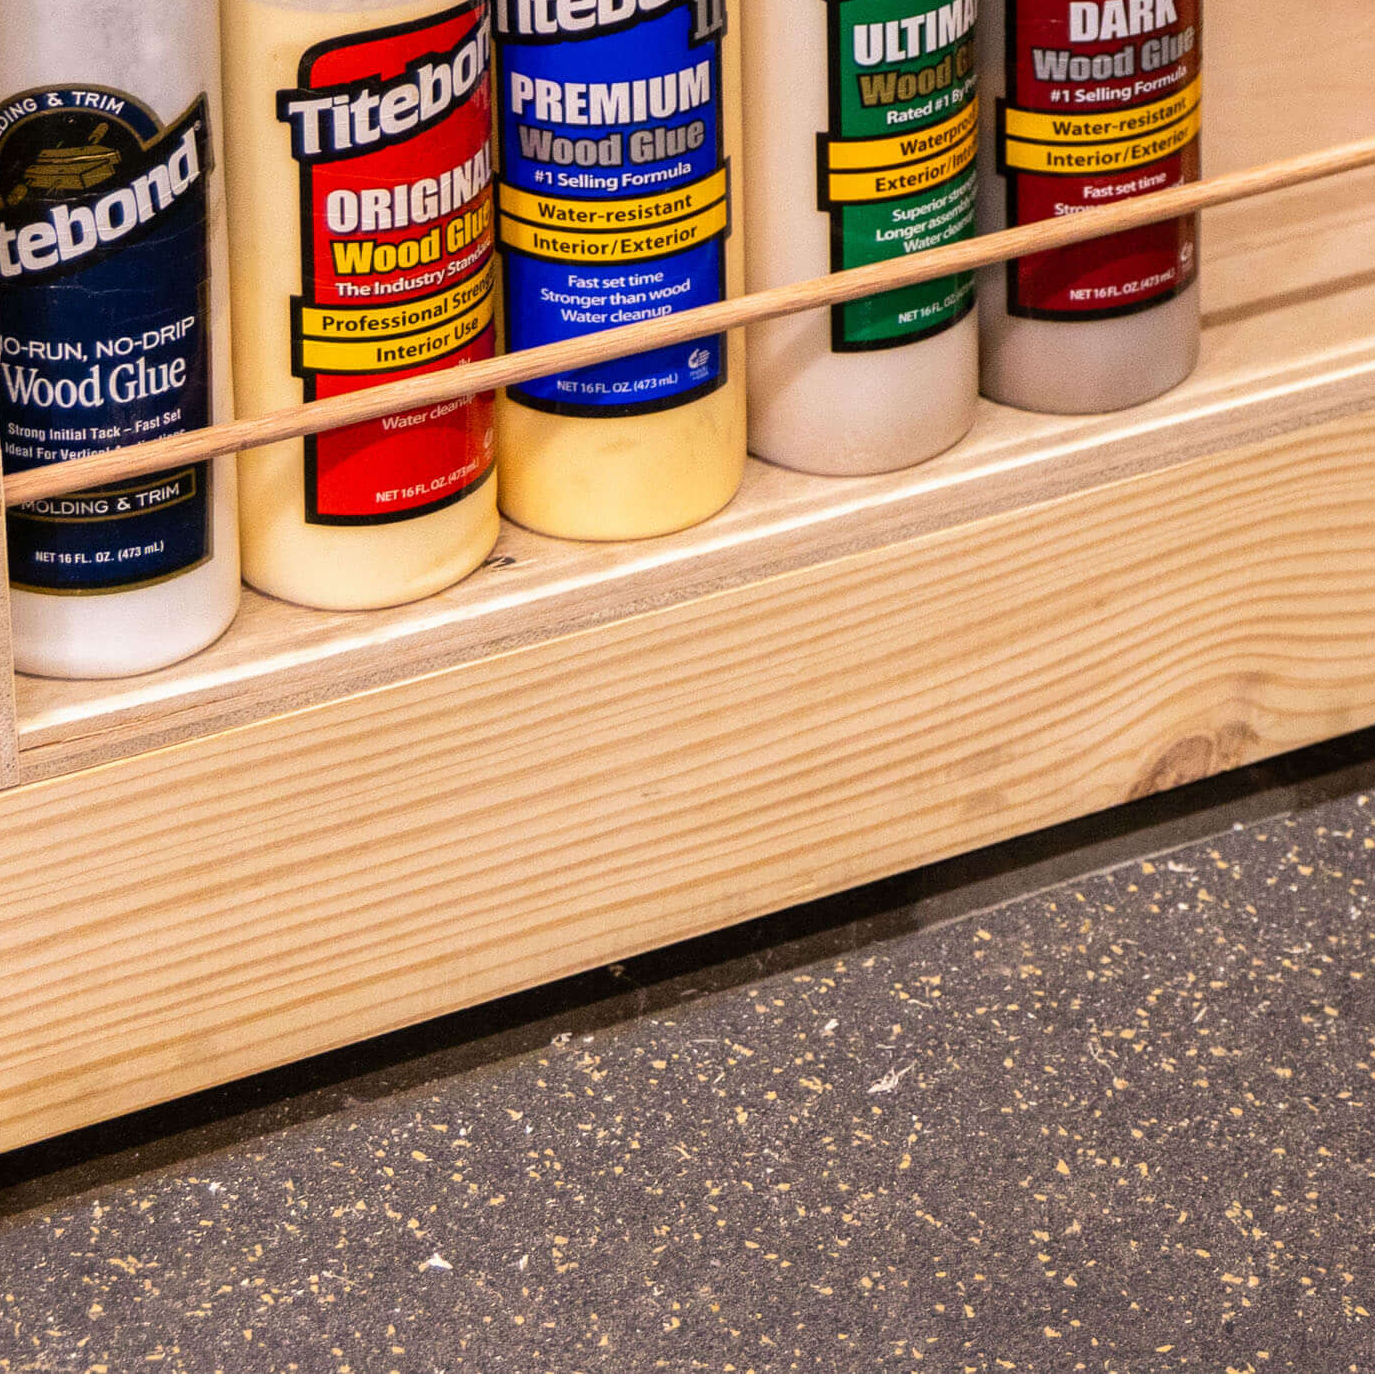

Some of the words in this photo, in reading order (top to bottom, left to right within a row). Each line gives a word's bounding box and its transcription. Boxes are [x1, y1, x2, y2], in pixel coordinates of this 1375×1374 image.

[1032, 46, 1134, 81] Wood
[1141, 25, 1195, 73] Glue
[511, 60, 710, 125] PREMIUM
[859, 55, 952, 107] Wood
[1050, 90, 1070, 102] #1
[1074, 86, 1132, 103] Selling
[1134, 65, 1187, 95] Formula
[47, 92, 64, 107] &
[72, 91, 124, 115] TRIM
[887, 100, 933, 124] Rated
[935, 95, 949, 111] #1
[1052, 97, 1187, 136] Water-resistant
[519, 125, 622, 166] Wood
[629, 120, 705, 164] Glue
[535, 170, 552, 185] #1
[558, 174, 618, 191] Selling
[622, 161, 692, 182] Formula
[1083, 185, 1113, 198] Fast
[1116, 183, 1136, 196] set
[1138, 172, 1166, 191] time
[538, 194, 693, 223] Water-resistant
[892, 197, 948, 222] Superior
[534, 224, 698, 256] Interior/Exterior
[876, 222, 928, 242] Longer
[904, 232, 942, 253] Water
[332, 226, 441, 276] Wood
[335, 282, 371, 297] The
[375, 268, 445, 295] Industry
[541, 288, 607, 309] Stronger
[610, 292, 646, 306] than
[650, 279, 691, 300] wood
[568, 275, 600, 289] Fast
[602, 275, 626, 289] set
[629, 271, 664, 286] time
[1070, 289, 1090, 300] NET
[1094, 289, 1106, 299] 16
[322, 297, 448, 331] Professional
[561, 309, 607, 323] Water
[610, 304, 672, 323] cleanup
[898, 309, 919, 323] NET
[921, 307, 932, 317] 16
[96, 316, 195, 359] NO-DRIP
[376, 332, 450, 362] Interior
[455, 316, 478, 340] Use
[1, 362, 104, 408] Wood
[108, 356, 186, 404] Glue
[557, 380, 577, 393] NET
[580, 382, 594, 393] 16
[634, 377, 657, 391] (473
[8, 422, 46, 442] Strong
[50, 427, 87, 441] Initial
[90, 425, 120, 439] Tack
[135, 418, 160, 433] Fast
[164, 408, 182, 425] Set
[382, 411, 428, 430] Water
[5, 443, 33, 459] Ideal
[36, 447, 57, 460] For
[117, 497, 131, 511] &
[136, 482, 180, 510] TRIM
[376, 489, 399, 503] NET
[401, 487, 414, 498] 16
[36, 551, 56, 563] NET
[58, 551, 72, 563] 16
[118, 545, 142, 562] (473
[145, 540, 165, 555] mL)
